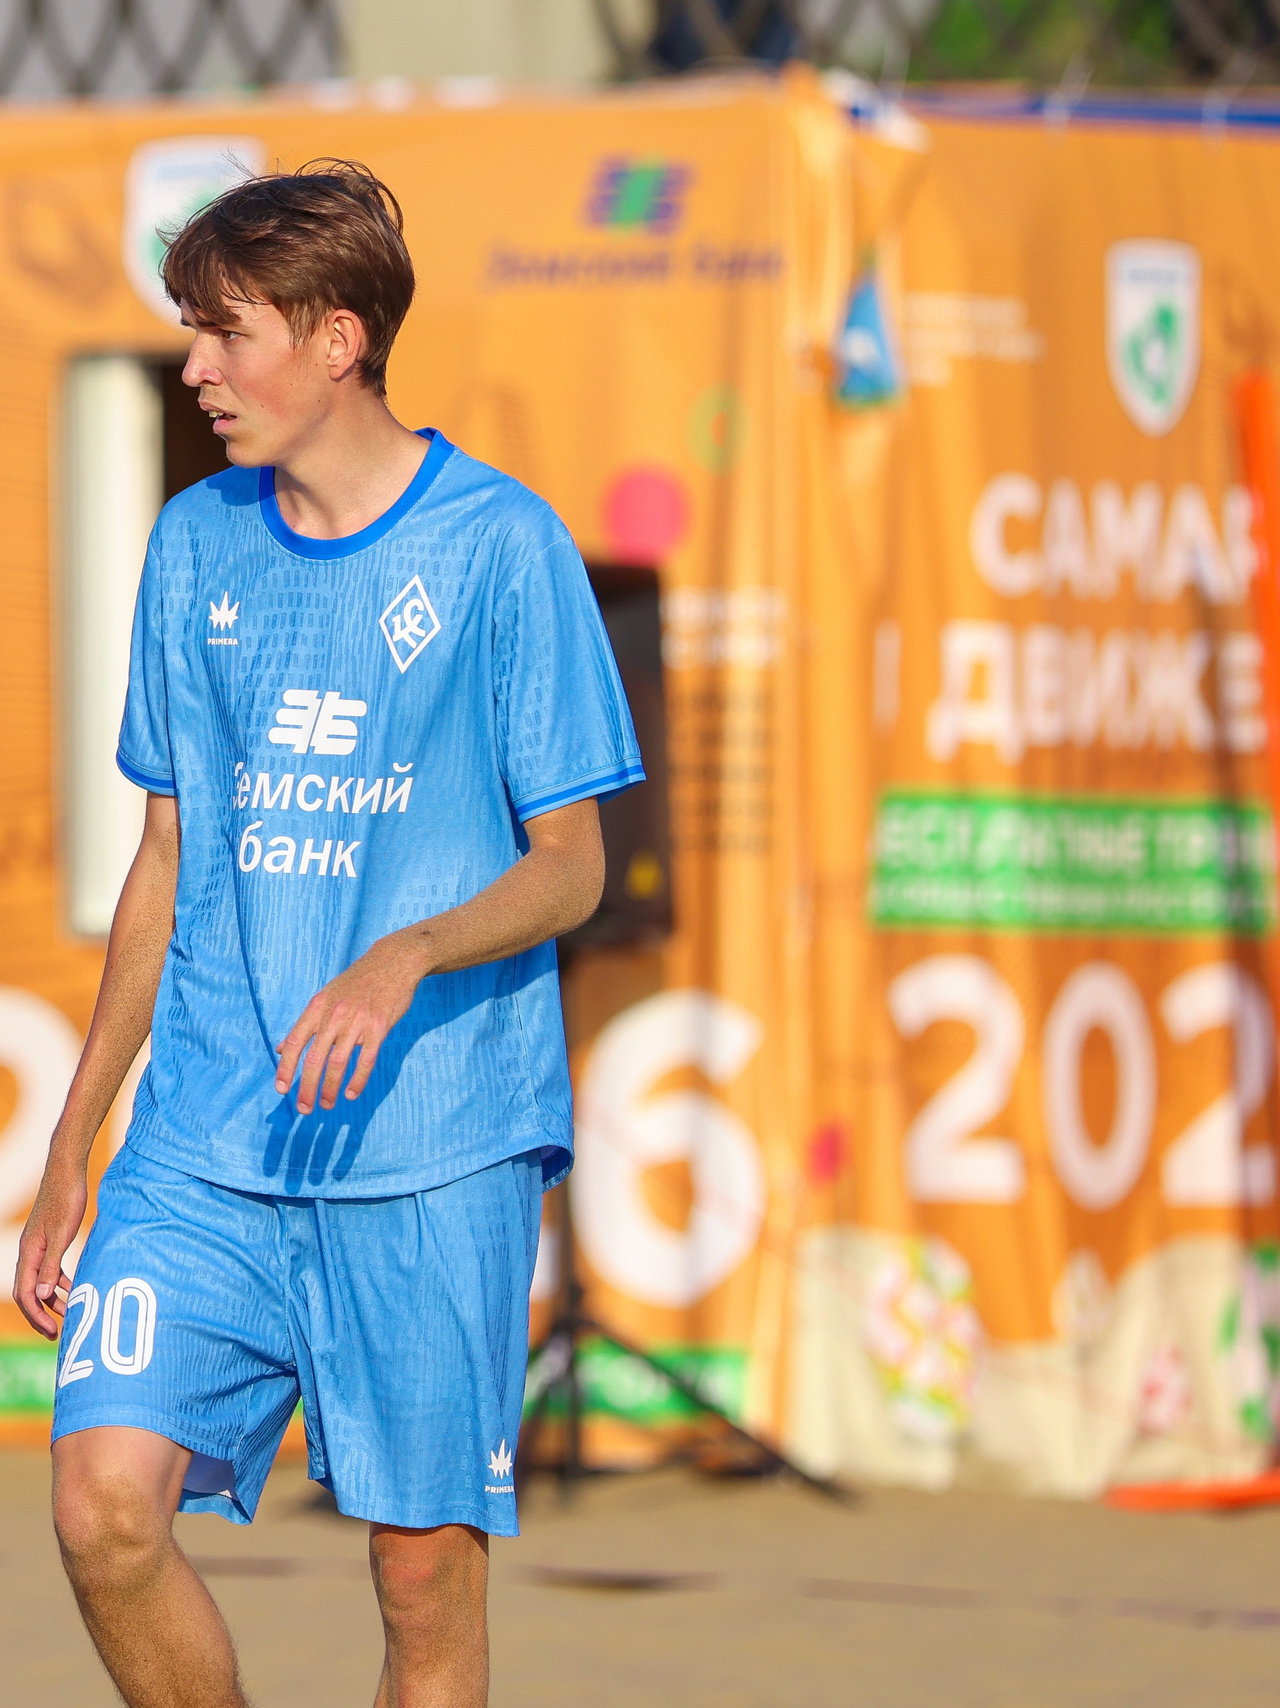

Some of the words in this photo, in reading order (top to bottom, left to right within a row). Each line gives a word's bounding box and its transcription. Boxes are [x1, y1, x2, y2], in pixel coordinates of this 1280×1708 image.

[207, 637, 239, 646] PRIMERA
[238, 820, 362, 878] банк
[58, 1277, 158, 1389] 20
